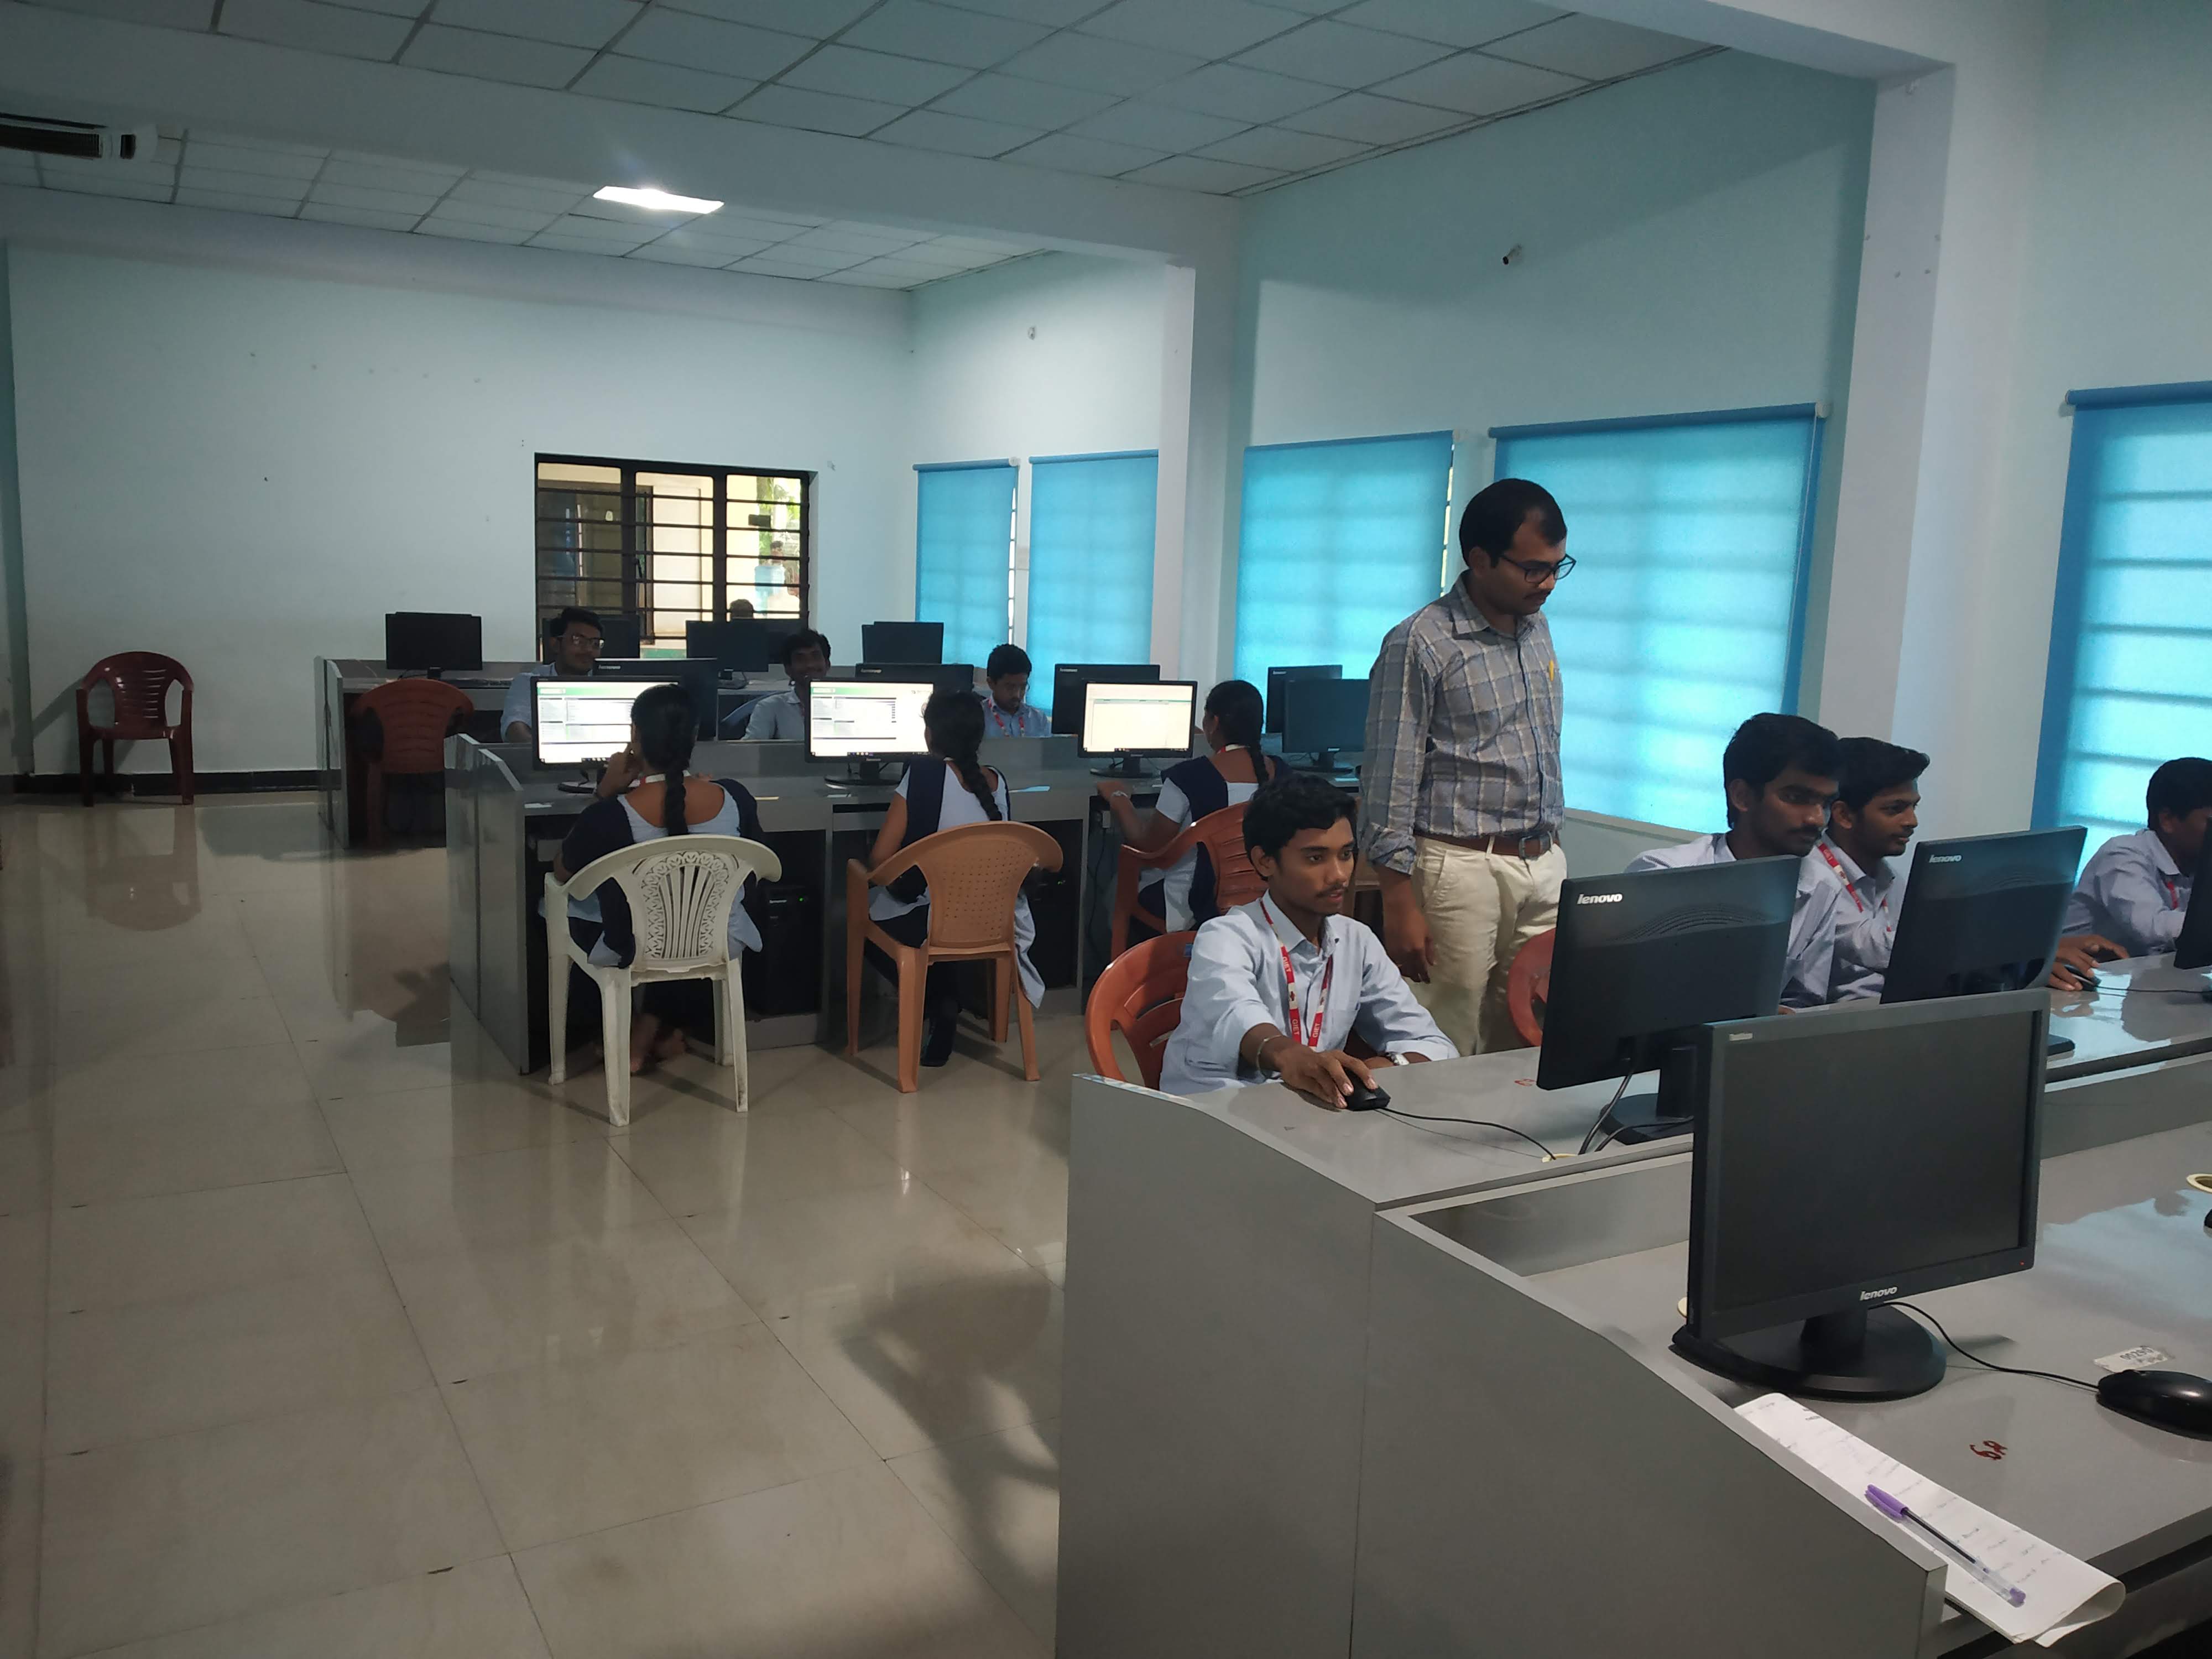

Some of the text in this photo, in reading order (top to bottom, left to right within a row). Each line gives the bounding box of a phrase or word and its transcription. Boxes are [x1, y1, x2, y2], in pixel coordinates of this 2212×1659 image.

[1929, 855, 1961, 863] lenovo
[1577, 894, 1623, 904] lenovo
[1860, 1286, 1897, 1301] lenovo
